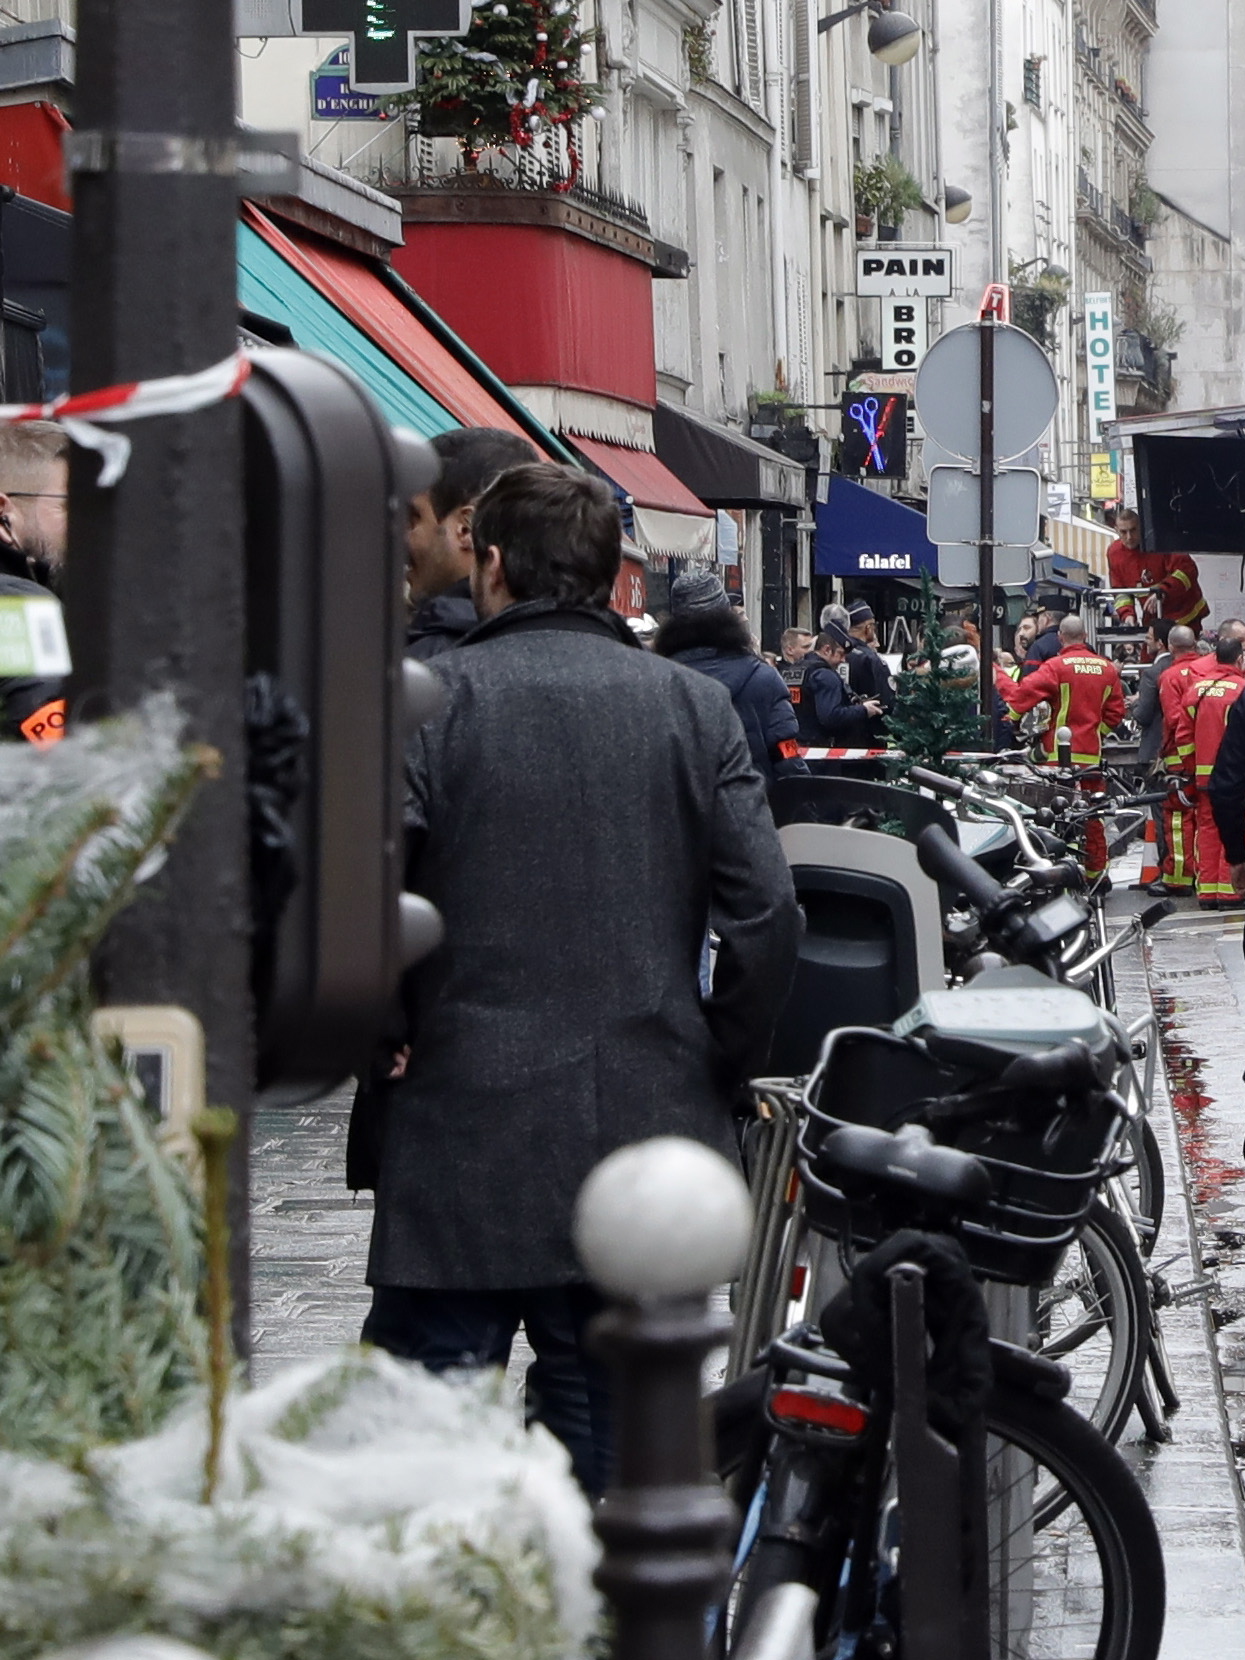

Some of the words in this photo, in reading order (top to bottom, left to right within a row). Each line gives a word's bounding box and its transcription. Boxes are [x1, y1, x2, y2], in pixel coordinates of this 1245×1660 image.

[317, 97, 374, 111] D'ENGHI
[863, 259, 945, 276] PAIN
[889, 288, 897, 297] A
[906, 287, 921, 297] LA
[1089, 311, 1111, 436] HOTEL
[866, 376, 914, 387] Sandwic
[859, 554, 911, 569] falafel
